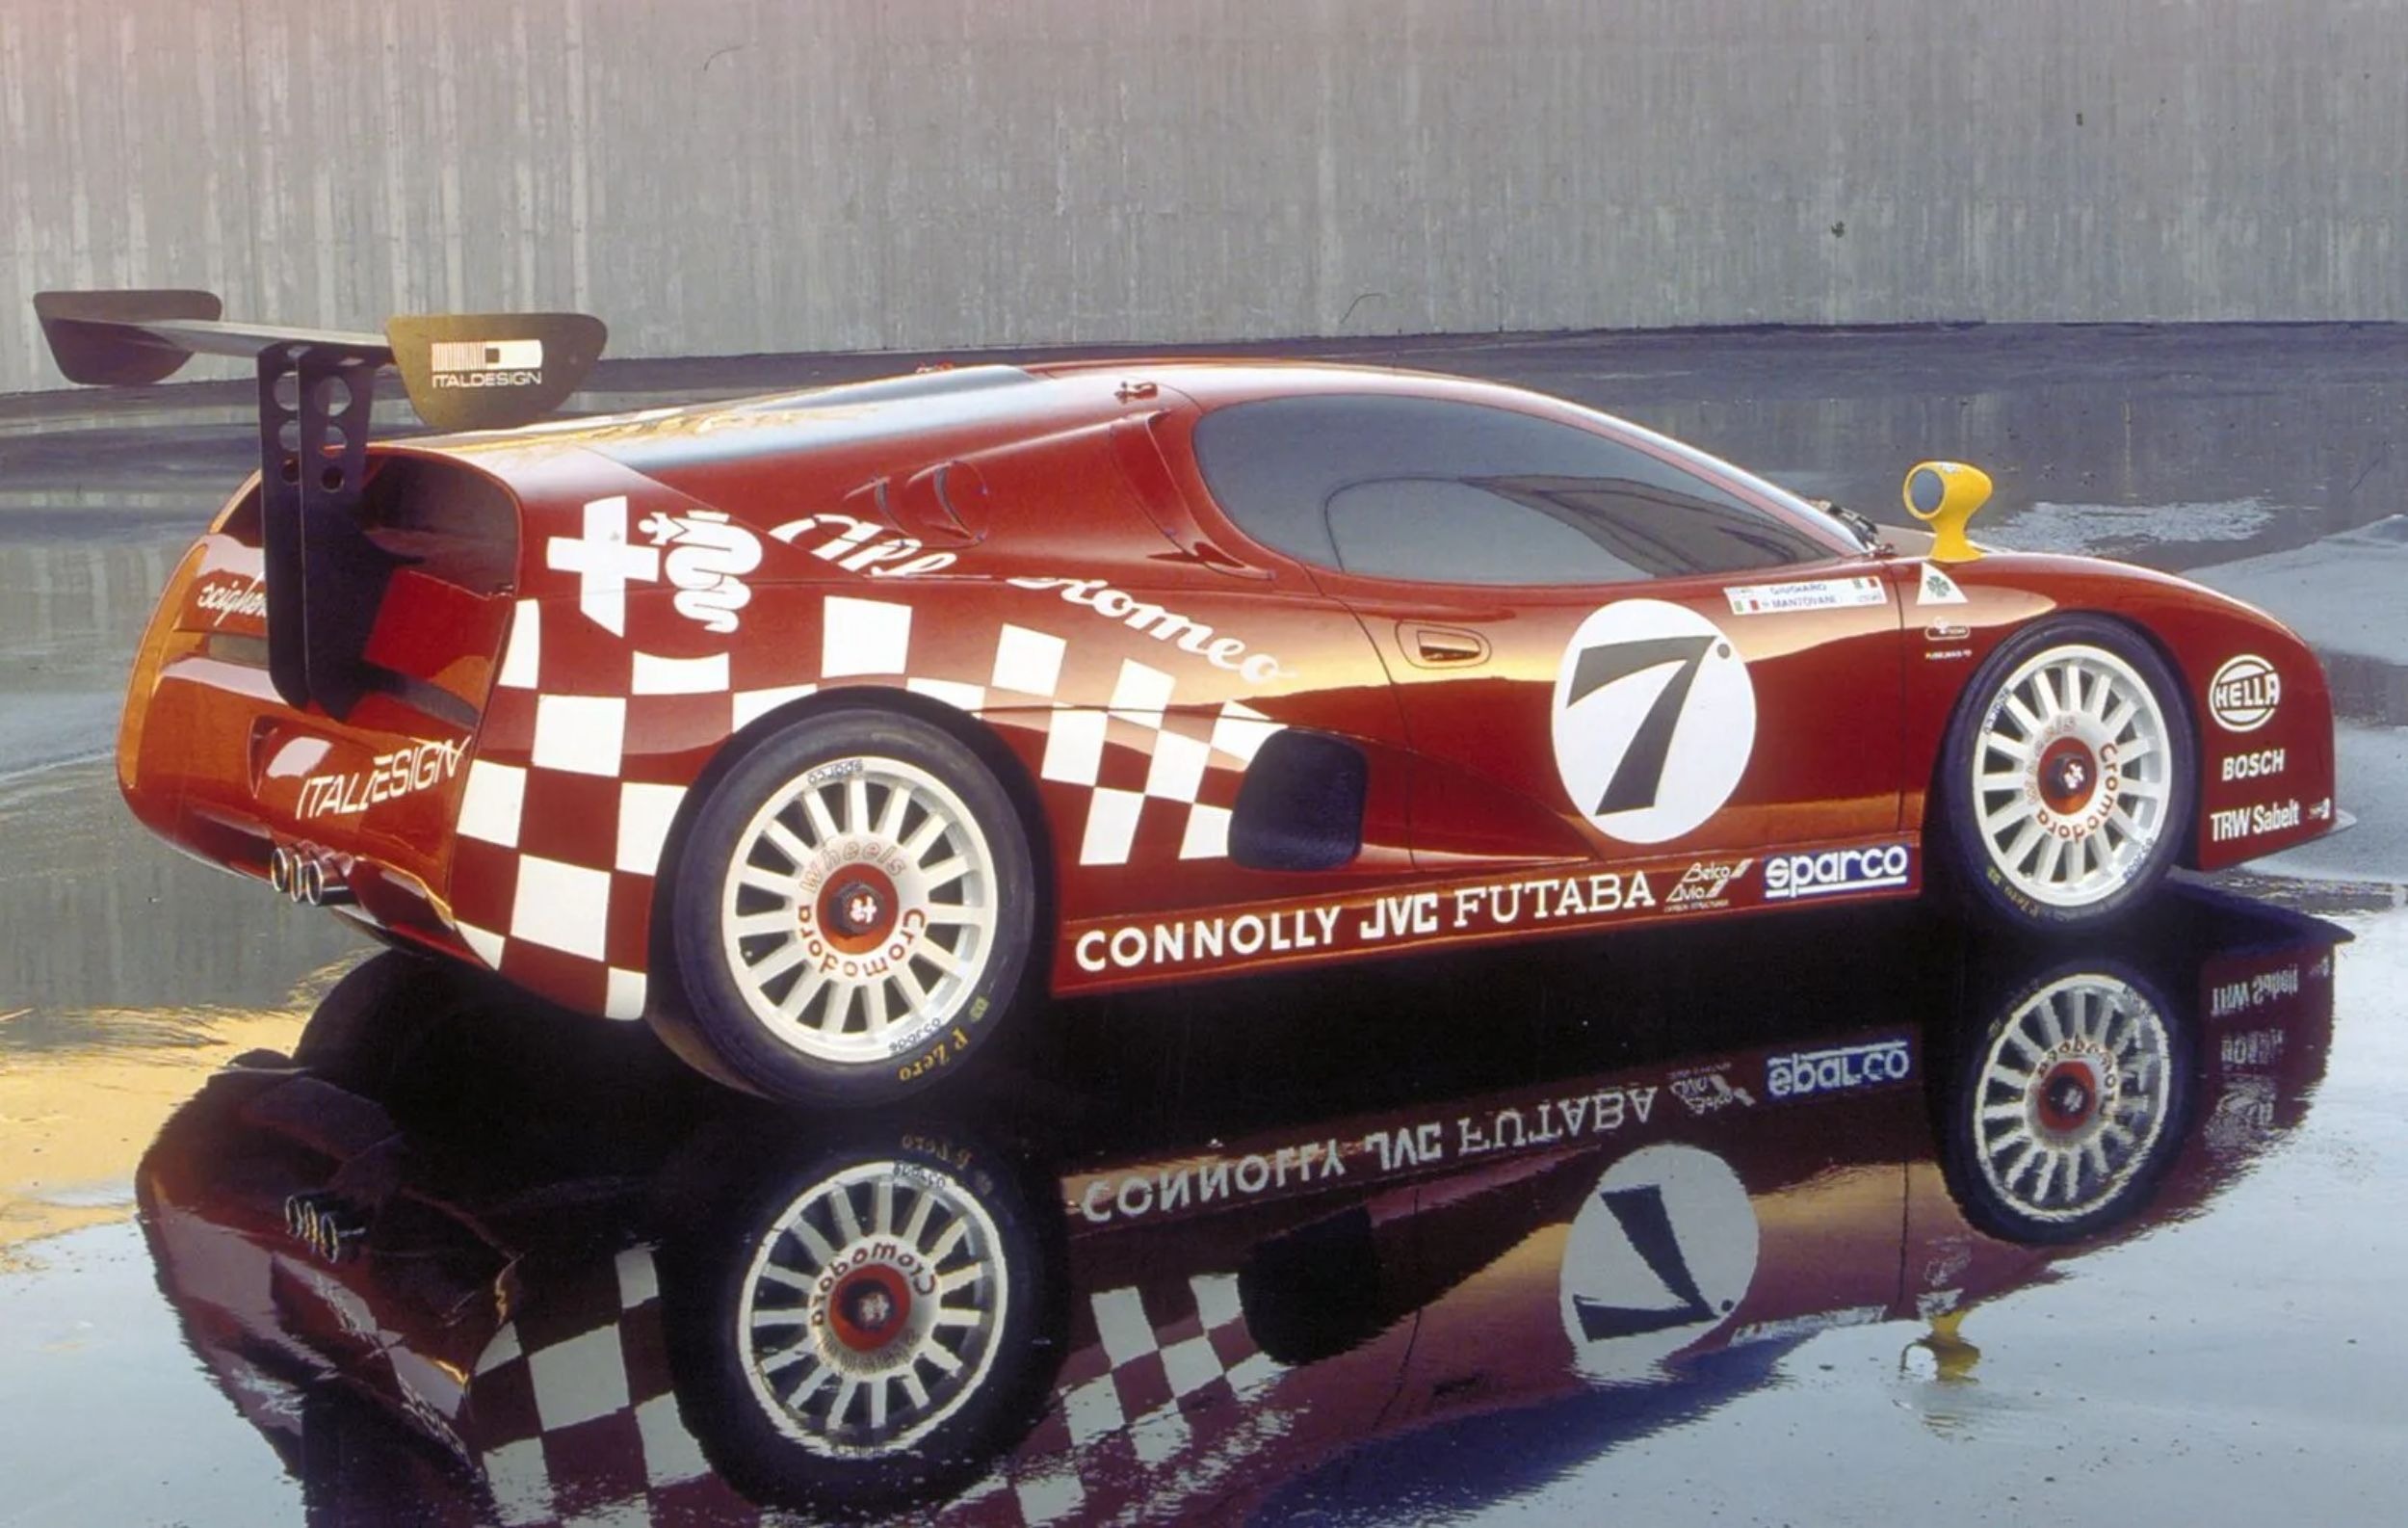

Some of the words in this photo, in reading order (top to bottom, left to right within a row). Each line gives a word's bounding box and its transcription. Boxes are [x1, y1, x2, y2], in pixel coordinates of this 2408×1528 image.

[432, 372, 542, 388] ITALDESIGN
[2216, 672, 2280, 708] HELLA
[1566, 635, 1717, 816] 7
[296, 735, 472, 820] ITALDESIGN
[2222, 748, 2286, 782] BOSCH
[2037, 743, 2118, 843] Cromodora
[2210, 806, 2251, 843] TRW
[2252, 798, 2300, 835] Sabelt
[1765, 846, 1908, 898] sparco
[798, 905, 926, 977] Cromodora
[1076, 906, 1341, 971] CONNOLLY
[1360, 893, 1438, 939] JVC
[1453, 871, 1655, 927] FUTABA
[898, 1042, 951, 1081] Zero
